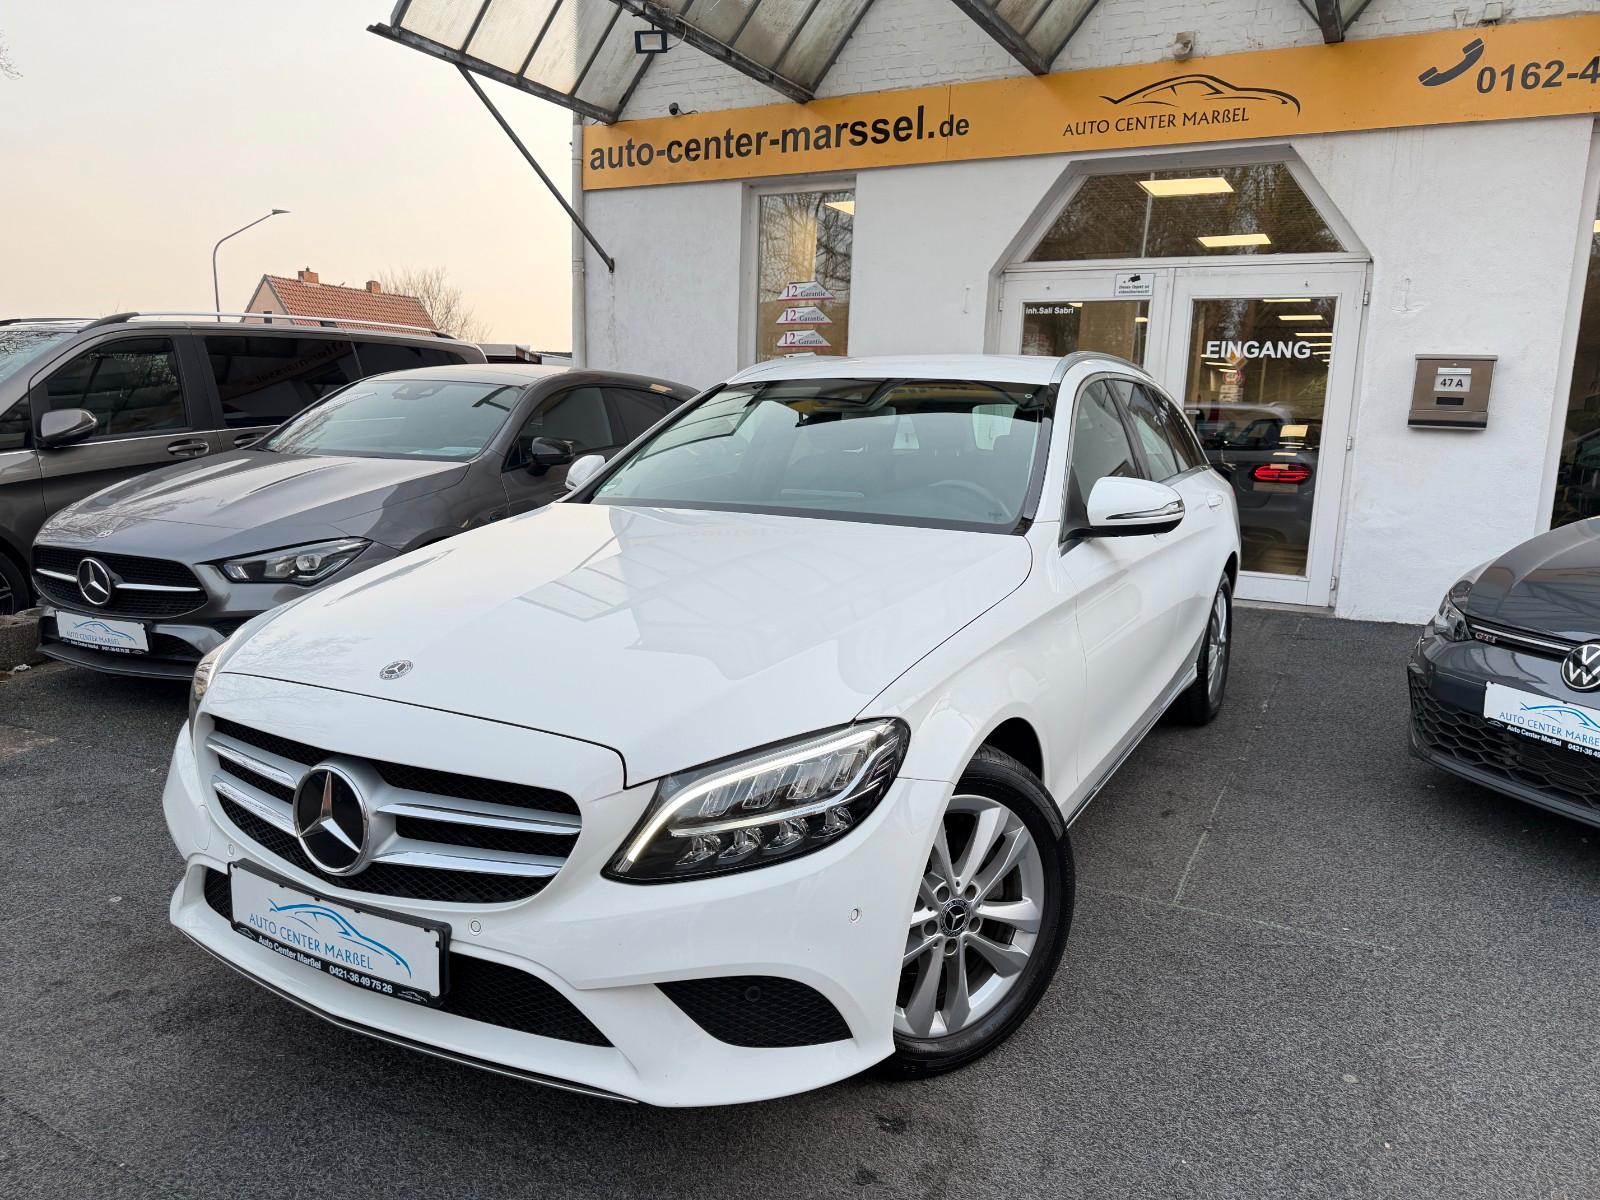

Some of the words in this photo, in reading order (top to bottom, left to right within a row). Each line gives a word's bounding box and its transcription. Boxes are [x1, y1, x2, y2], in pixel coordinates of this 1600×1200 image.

[1062, 119, 1110, 137] AUTO
[1115, 113, 1176, 132] CENTER
[1182, 107, 1249, 126] MARßEL
[590, 105, 970, 171] auto-center-marssel.de
[785, 285, 798, 297] 12
[784, 309, 797, 321] 12
[1054, 306, 1074, 315] Sabri
[784, 332, 796, 345] 12
[1206, 340, 1311, 359] EINGANG
[1440, 378, 1453, 387] 47
[1455, 378, 1463, 387] A
[1475, 632, 1499, 644] GTI
[1499, 711, 1525, 725] AUTO
[1527, 719, 1562, 736] CENTER
[1506, 724, 1521, 734] Auto
[1520, 728, 1541, 740] Center
[1567, 743, 1593, 756] 0421-36
[249, 913, 277, 935] AUTO
[280, 926, 321, 953] CENTER
[324, 943, 374, 970] MARßEL
[258, 935, 273, 949] Auto
[274, 943, 297, 960] Center
[329, 965, 360, 983] 0421-36
[360, 976, 371, 987] 49
[371, 979, 381, 990] 75
[382, 983, 393, 994] 26
